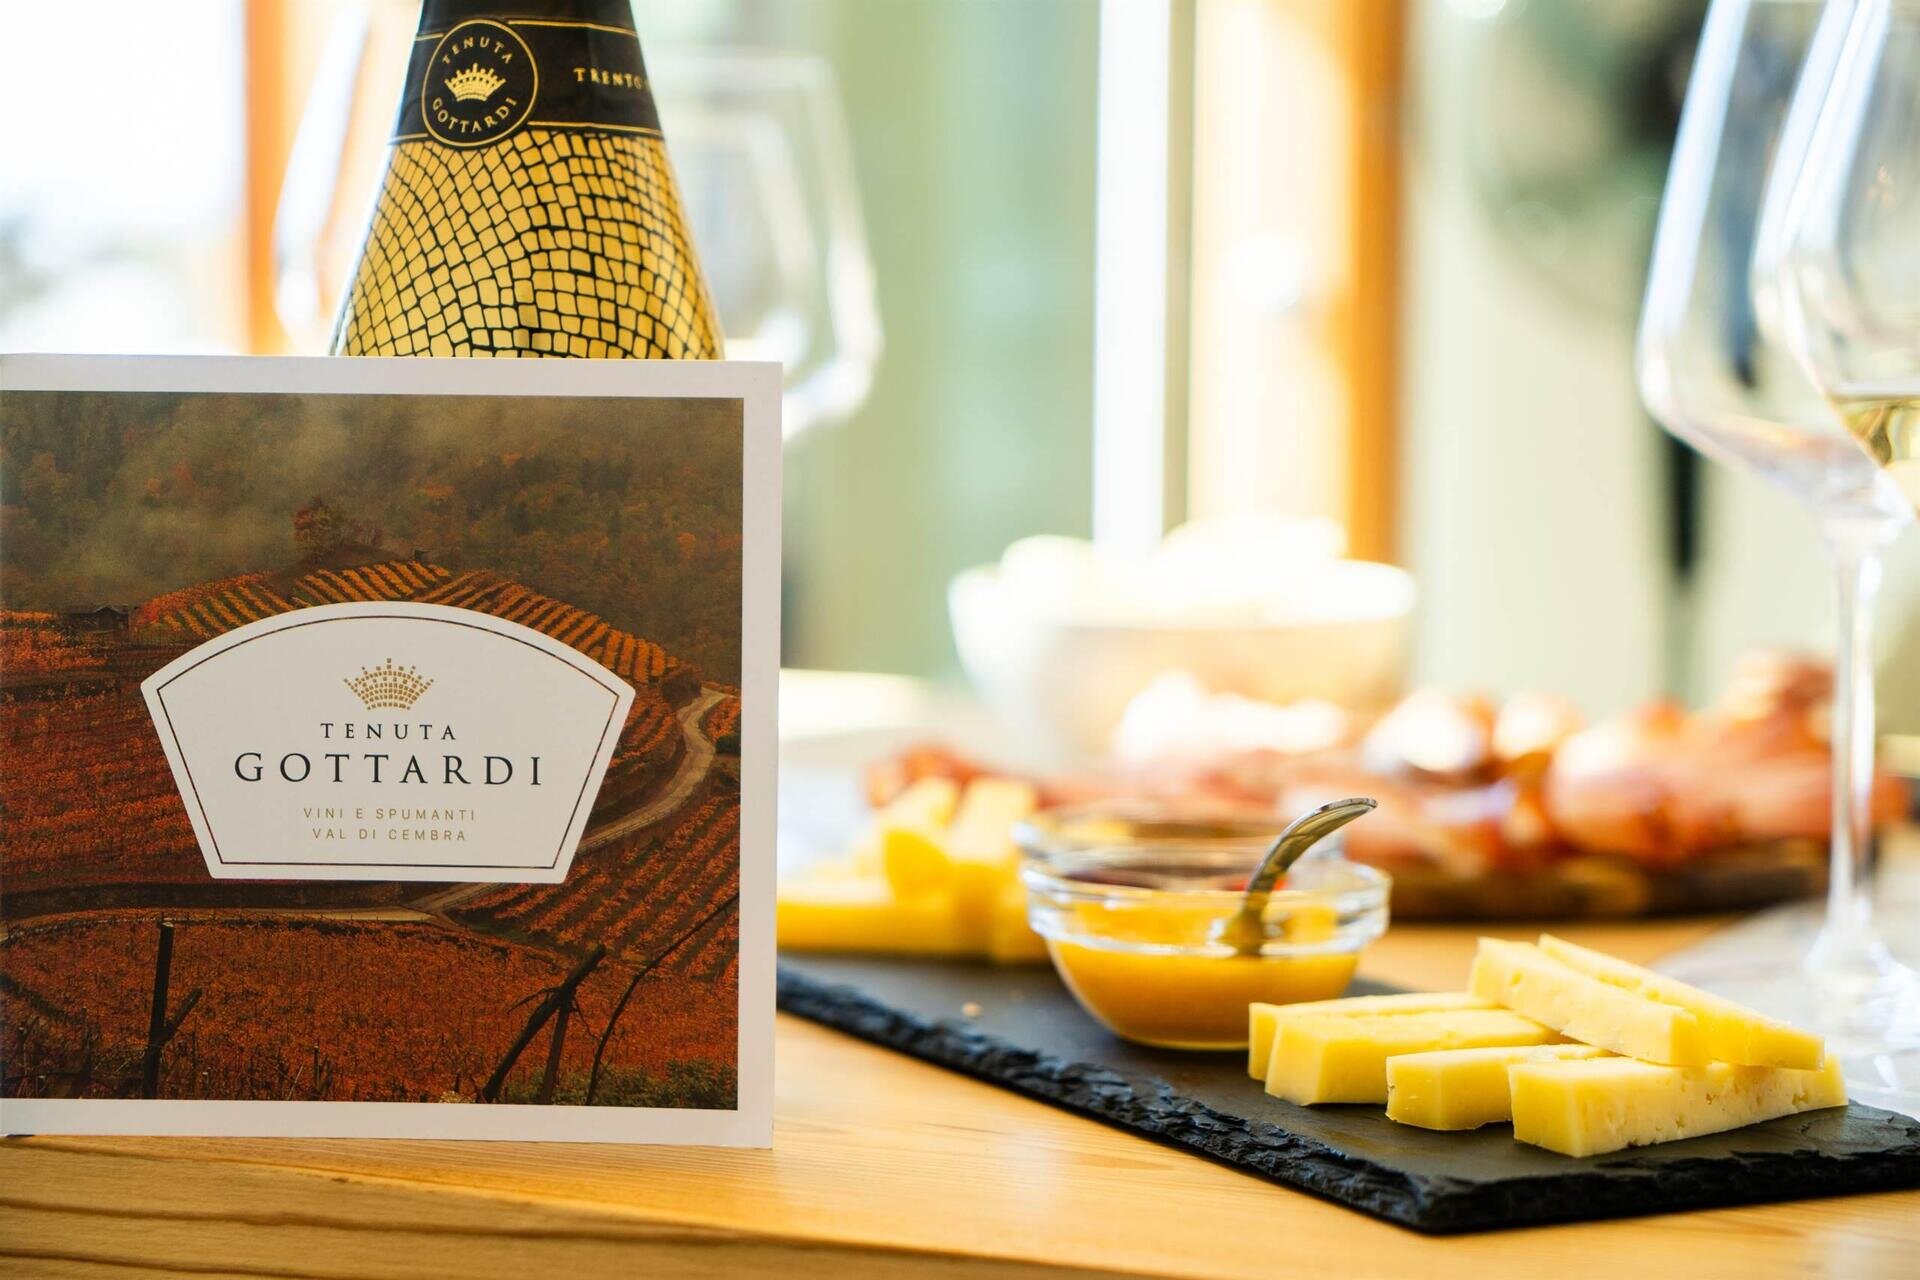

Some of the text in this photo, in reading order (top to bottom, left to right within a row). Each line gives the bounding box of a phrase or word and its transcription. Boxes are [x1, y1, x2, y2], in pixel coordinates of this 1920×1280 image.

[442, 35, 514, 65] TENUTA
[432, 96, 518, 133] GOTTARDI
[320, 722, 457, 741] TENUTA
[234, 752, 542, 786] GOTTARDI
[303, 807, 476, 822] VINI E SPUMANTI
[312, 828, 467, 842] VAL DI CEMBRA
